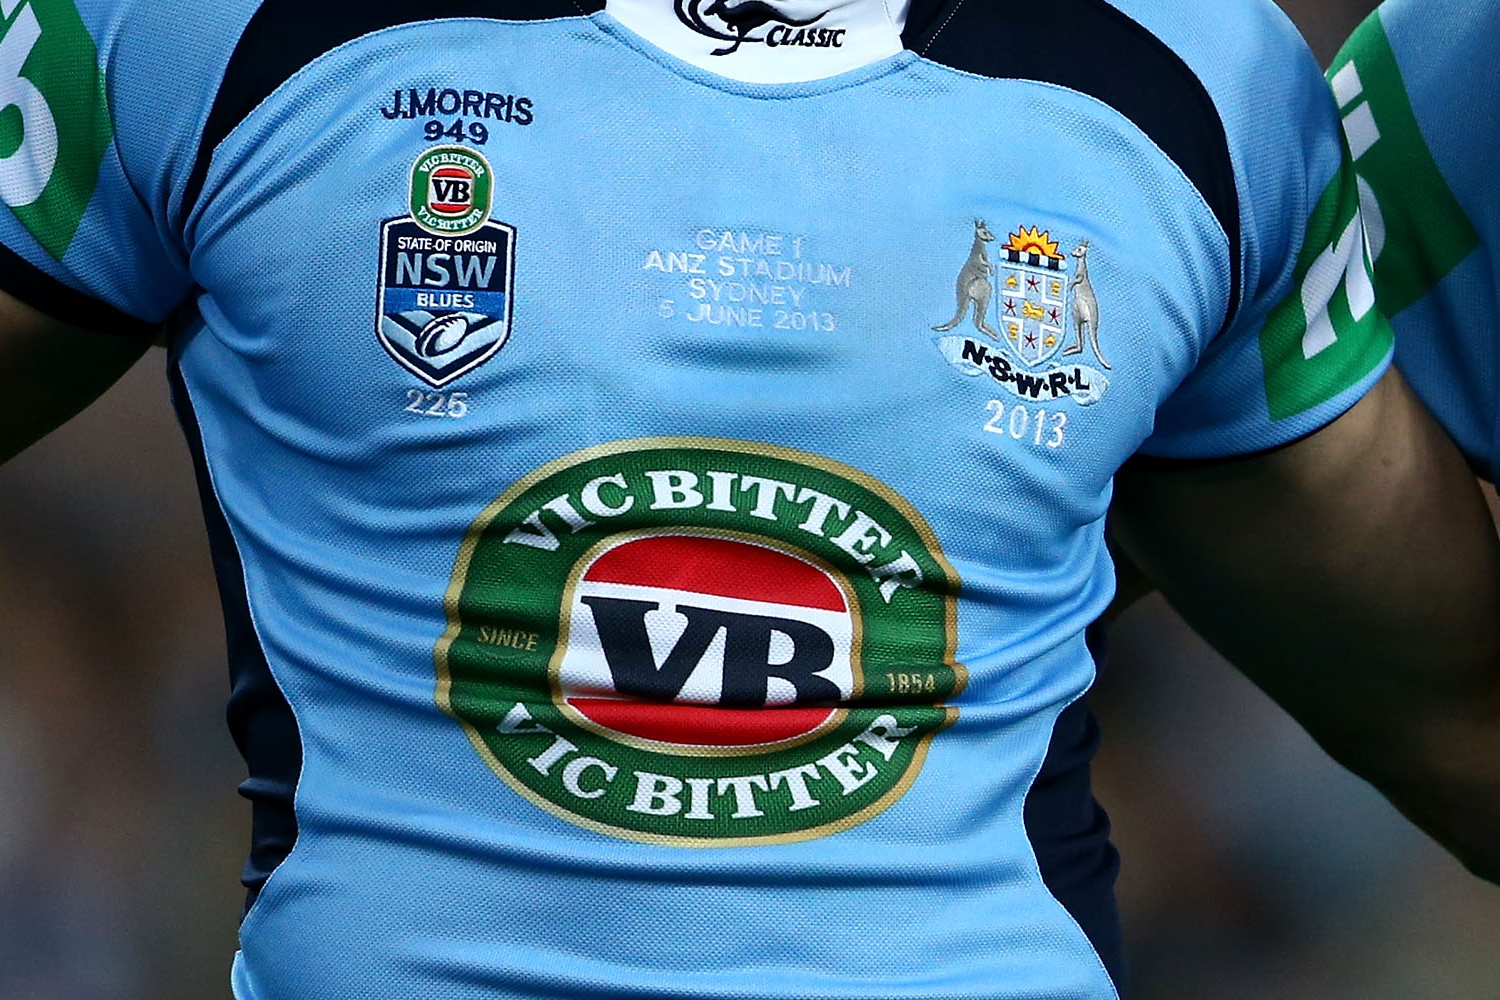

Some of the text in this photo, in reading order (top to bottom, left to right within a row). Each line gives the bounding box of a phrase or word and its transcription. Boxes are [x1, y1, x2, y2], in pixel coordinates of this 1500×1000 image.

[766, 25, 846, 47] CLASSIC
[381, 88, 534, 125] J.MORRIS
[423, 117, 489, 145] 949
[419, 154, 440, 174] VIC
[431, 179, 470, 202] VB
[398, 236, 497, 254] STATE OF ORIGIN
[696, 229, 802, 259] GAME 1
[395, 252, 497, 288] NSW
[643, 250, 852, 287] ANZ STADIUM
[416, 293, 474, 308] BLUES
[689, 277, 805, 307] SYDNEY
[658, 299, 836, 332] 5 JUNE 2013
[404, 389, 469, 418] 225
[983, 399, 1068, 449] 2013
[503, 469, 926, 604] VIC BITTER
[477, 625, 540, 652] SINCE
[580, 596, 841, 709] VB
[886, 672, 936, 693] 1854
[496, 702, 918, 821] VIC BITTER
